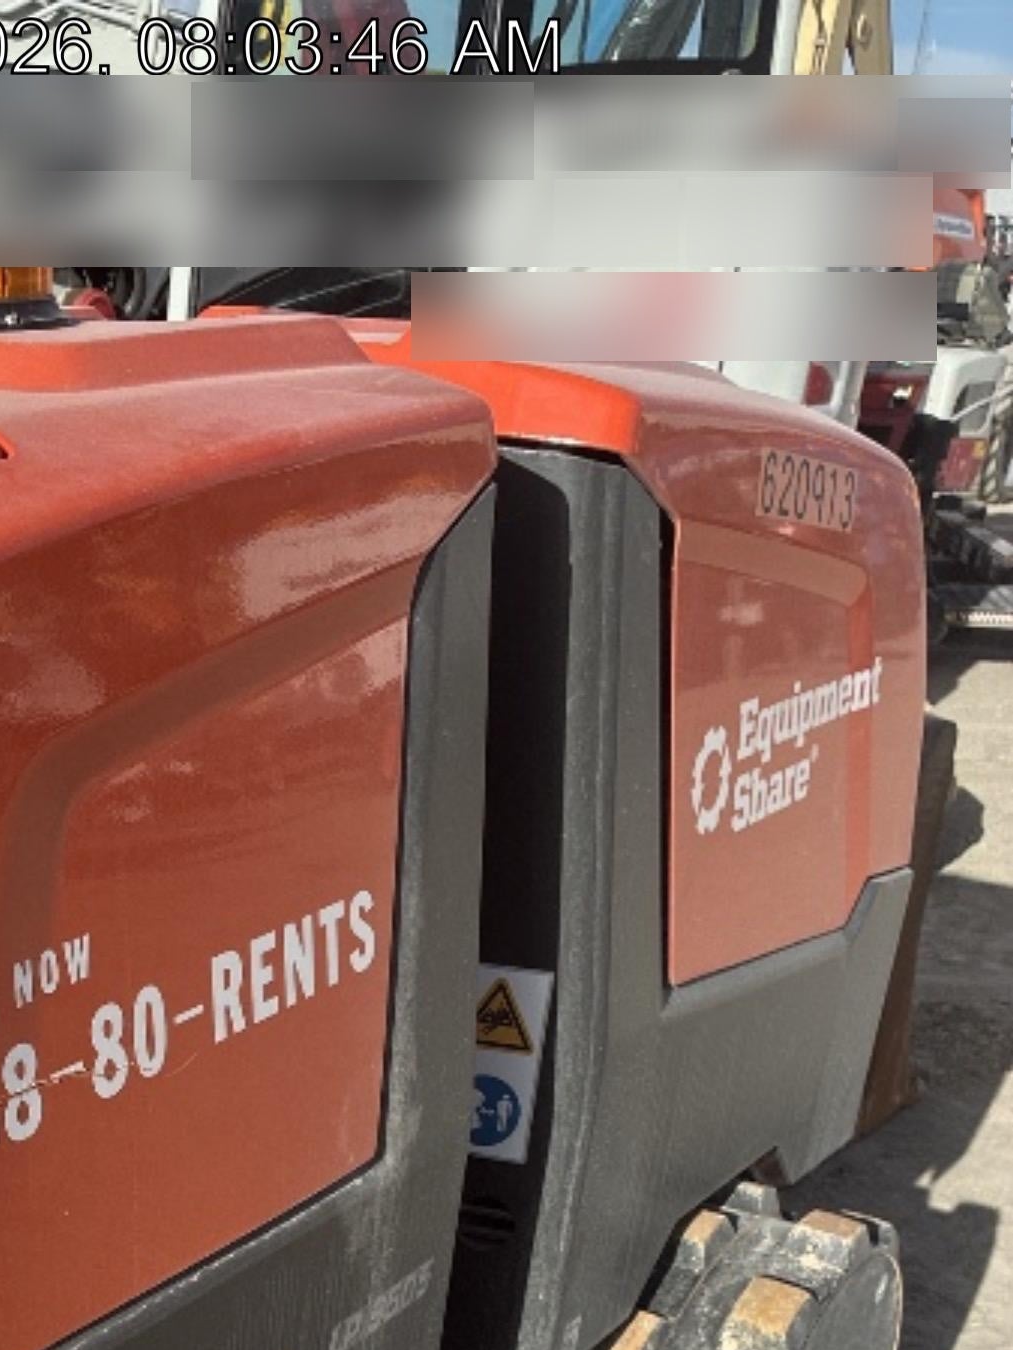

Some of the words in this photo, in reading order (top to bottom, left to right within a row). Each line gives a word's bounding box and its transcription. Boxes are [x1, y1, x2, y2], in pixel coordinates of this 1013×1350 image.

[761, 451, 855, 530] 620913
[737, 655, 882, 765] Equipment
[12, 932, 90, 1008] NOW
